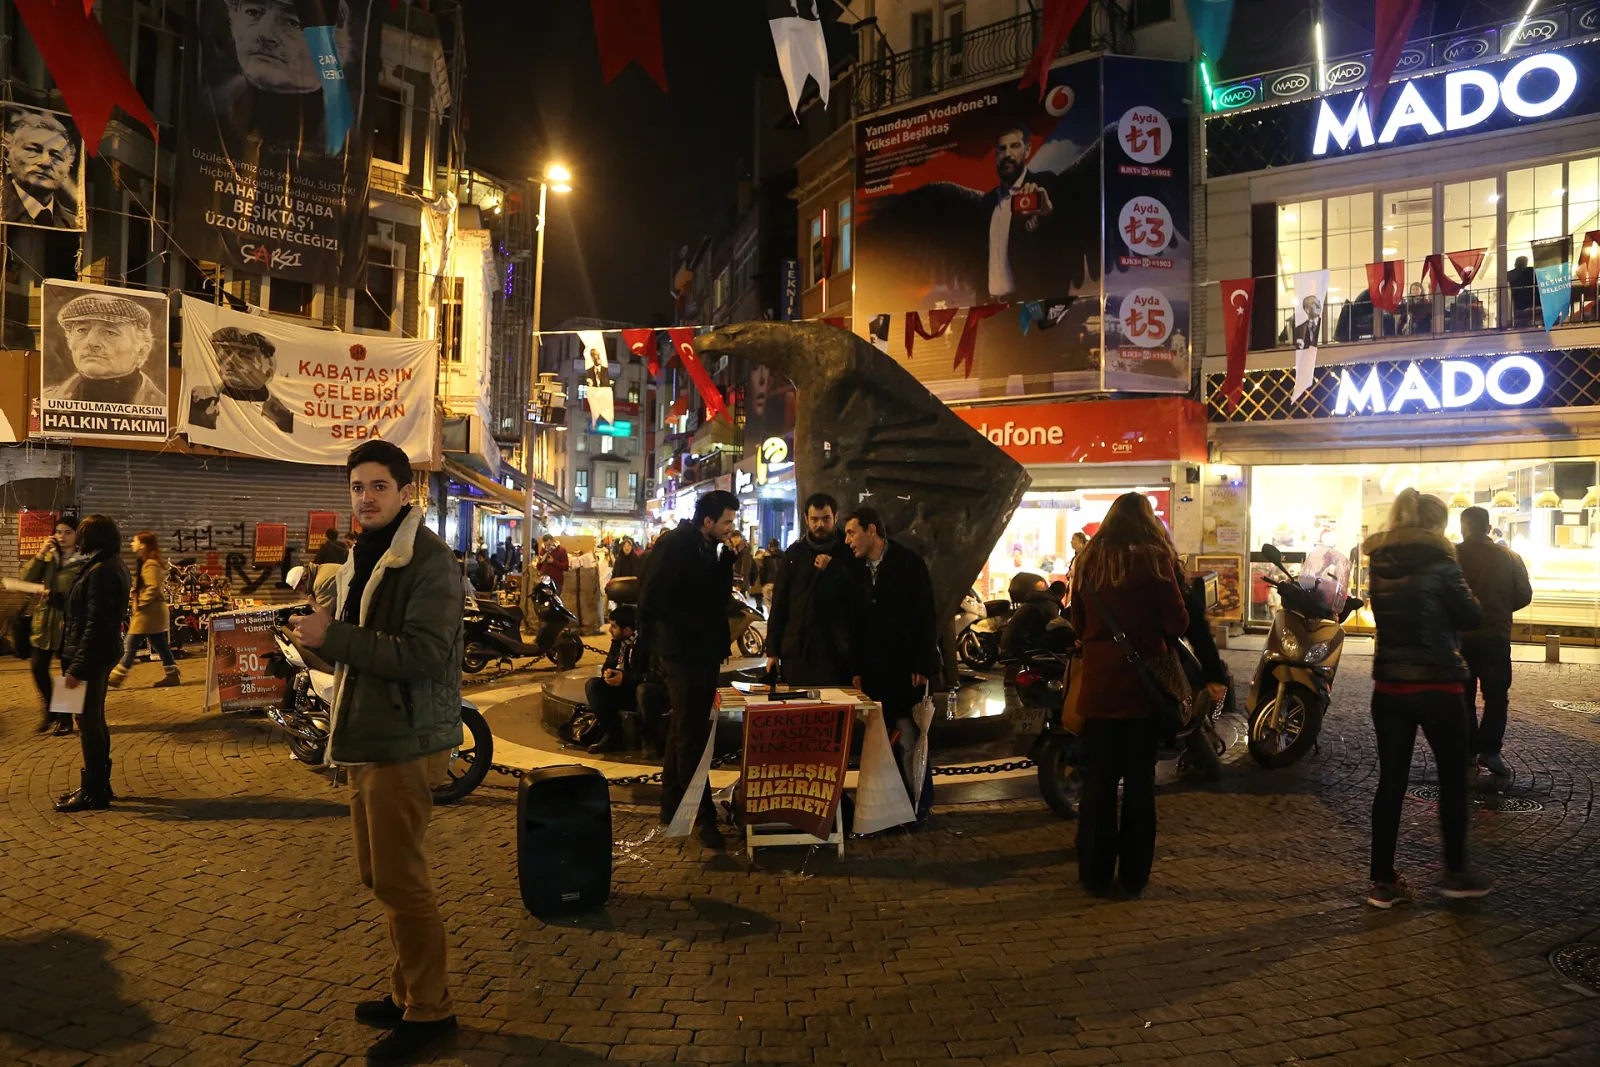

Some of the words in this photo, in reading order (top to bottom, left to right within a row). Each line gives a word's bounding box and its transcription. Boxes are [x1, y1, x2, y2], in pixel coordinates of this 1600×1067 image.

[1396, 54, 1421, 67] ADO
[1331, 66, 1361, 80] MADO
[1276, 78, 1305, 91] MADO
[1224, 90, 1251, 103] MADO
[1312, 53, 1577, 155] MADO
[865, 112, 928, 137] Yanındayım
[929, 94, 999, 121] Vodafone'la
[1132, 112, 1158, 124] Ayda
[865, 134, 901, 152] Yüksel
[902, 122, 950, 143] Beşiktaş
[258, 166, 275, 179] çok
[214, 180, 261, 201] RAHAT
[264, 192, 293, 209] UYU
[296, 200, 334, 218] BABA
[1133, 203, 1159, 215] Ayda
[205, 210, 338, 251] ÜZDÜRMEYECEĞİZ!
[1134, 295, 1160, 307] Ayda
[298, 359, 413, 386] KABATAŞ'IN
[313, 382, 399, 401] ÇELEBİSİ
[1334, 355, 1544, 415] MADO
[48, 399, 163, 415] UNUTULMAYACAKSIN
[304, 399, 406, 421] SÜLEYMAN
[45, 413, 108, 430] HALKIN
[110, 418, 165, 433] TAKIMI
[331, 424, 382, 440] SEBA
[243, 624, 271, 633] TÜRKİY
[248, 615, 275, 625] Şansla
[239, 653, 259, 673] 50
[240, 683, 256, 694] 286
[747, 763, 839, 782] BİRLEŞİK
[746, 778, 836, 801] HAZİRAN
[746, 795, 830, 818] HAREKETİ
